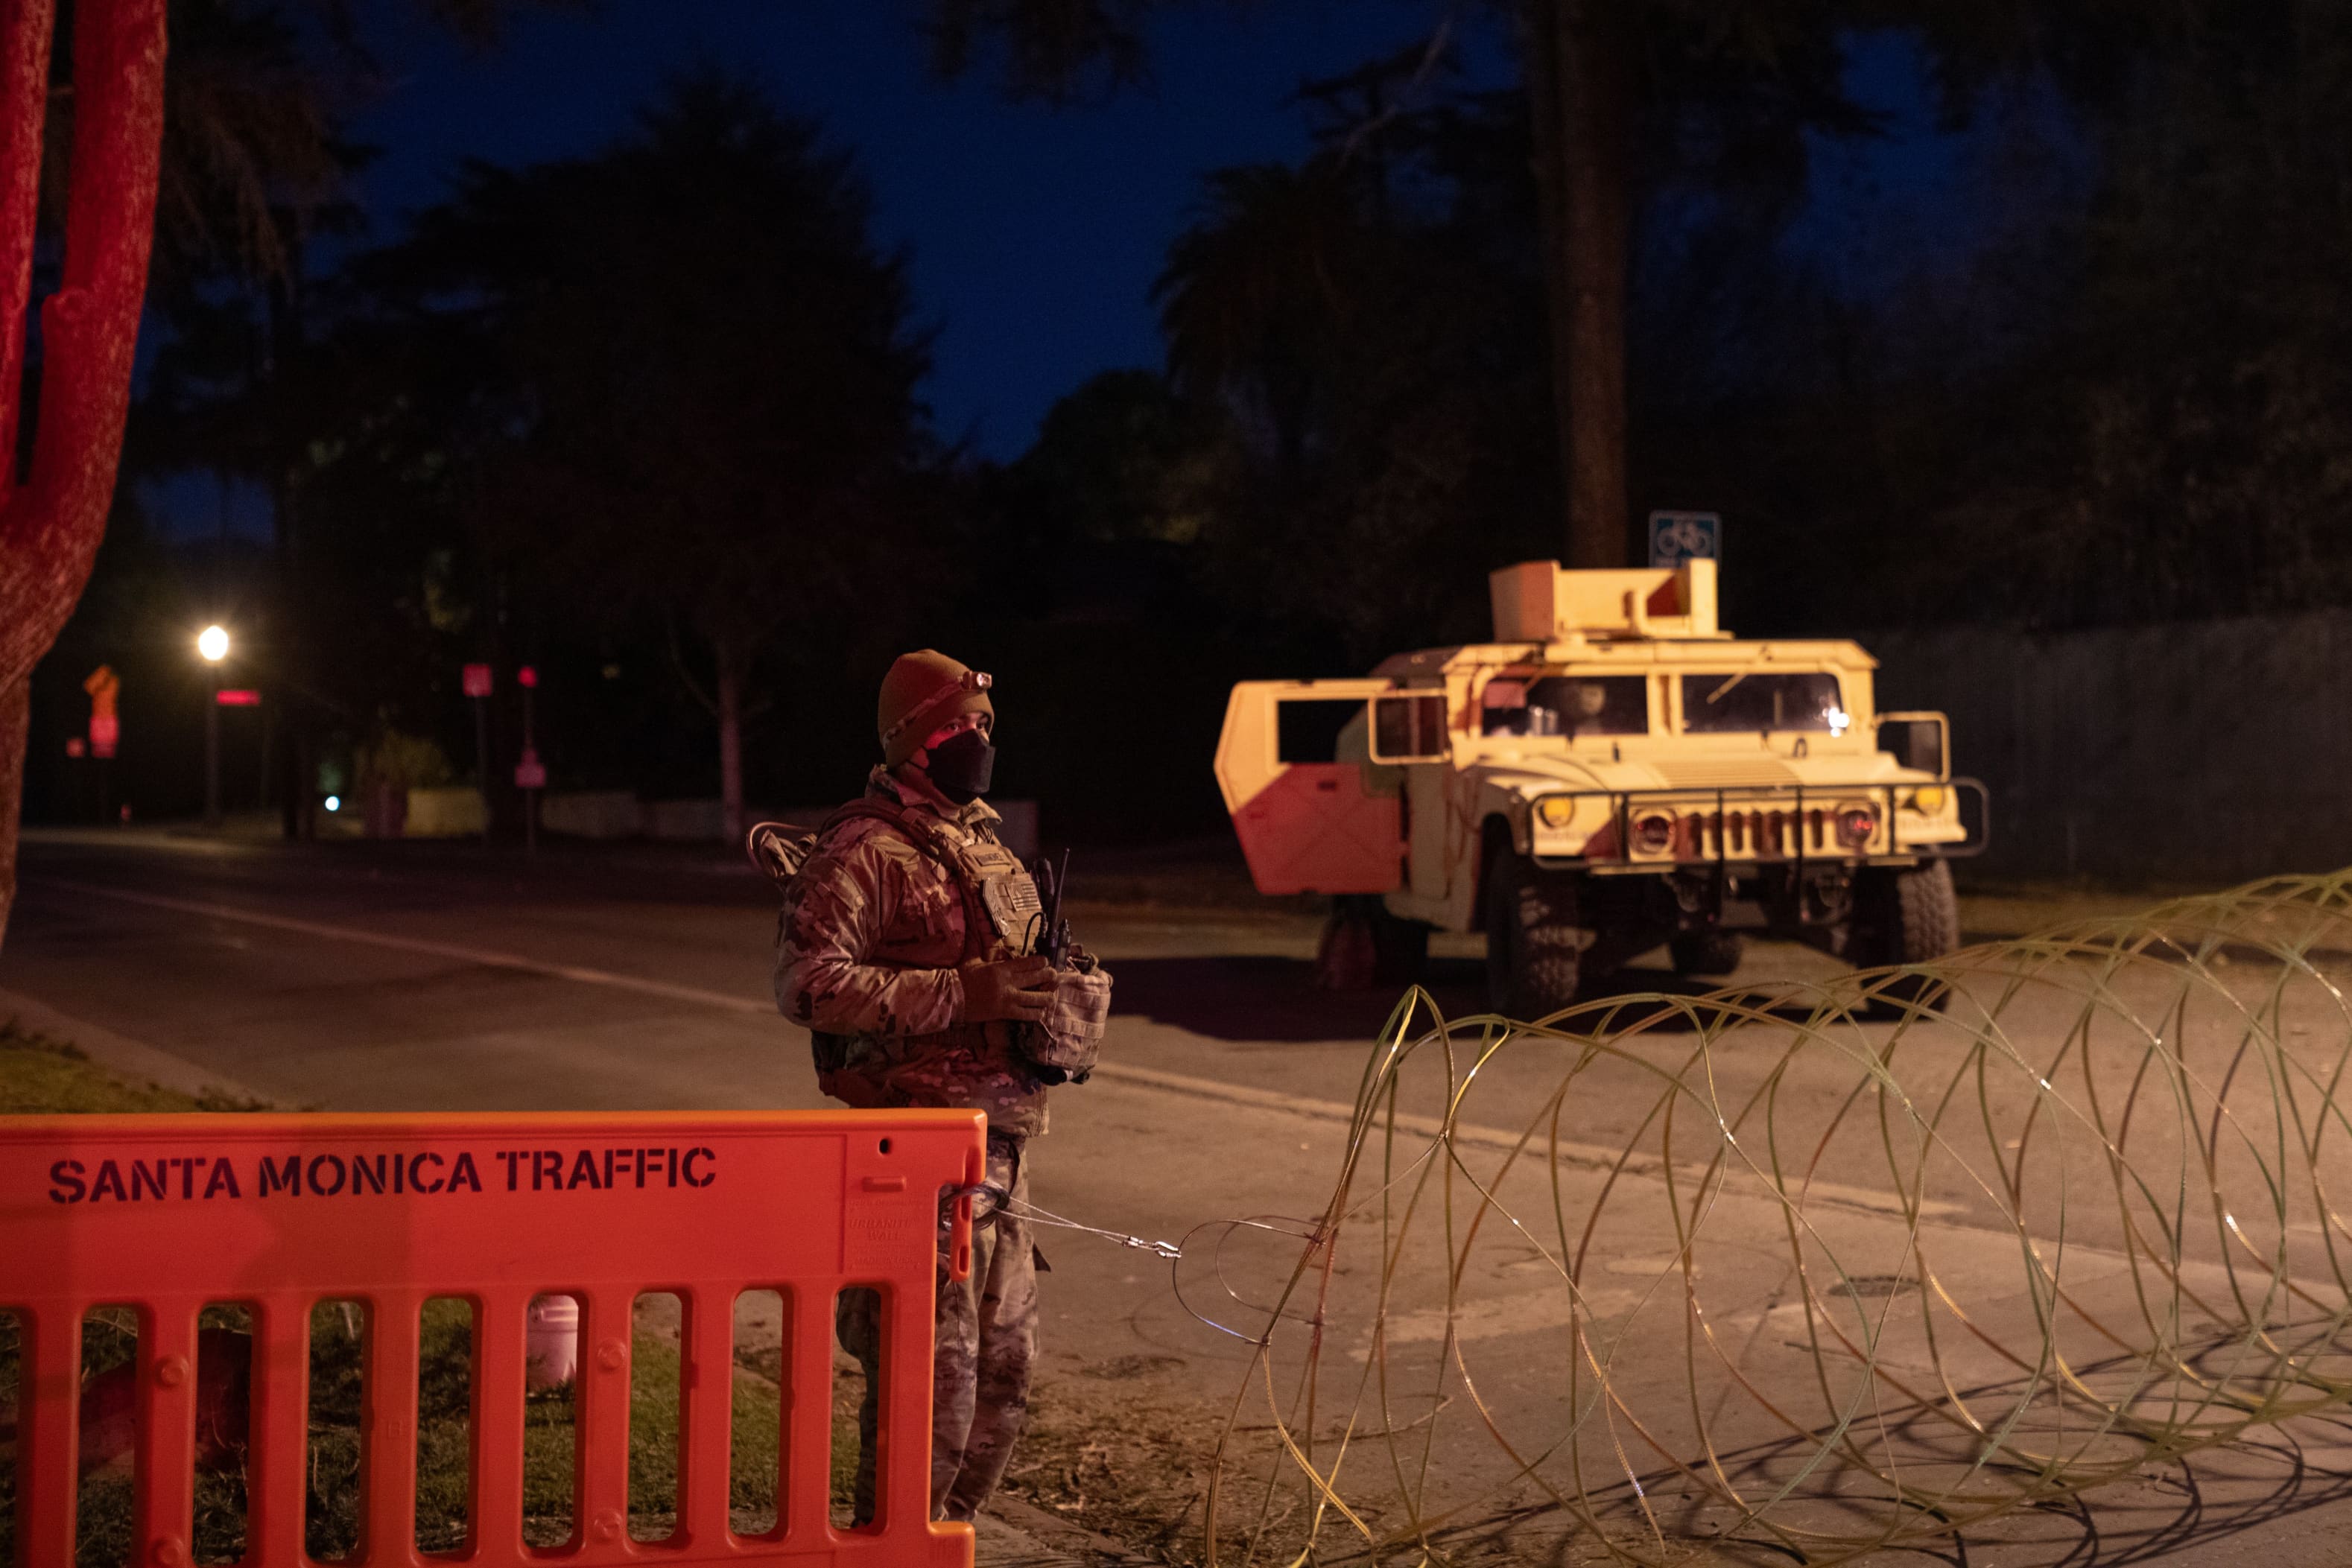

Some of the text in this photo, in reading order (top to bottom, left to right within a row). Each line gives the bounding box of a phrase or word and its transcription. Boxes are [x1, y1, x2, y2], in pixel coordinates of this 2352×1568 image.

[48, 1148, 714, 1204] SANTA MONICA TRAFFIC
